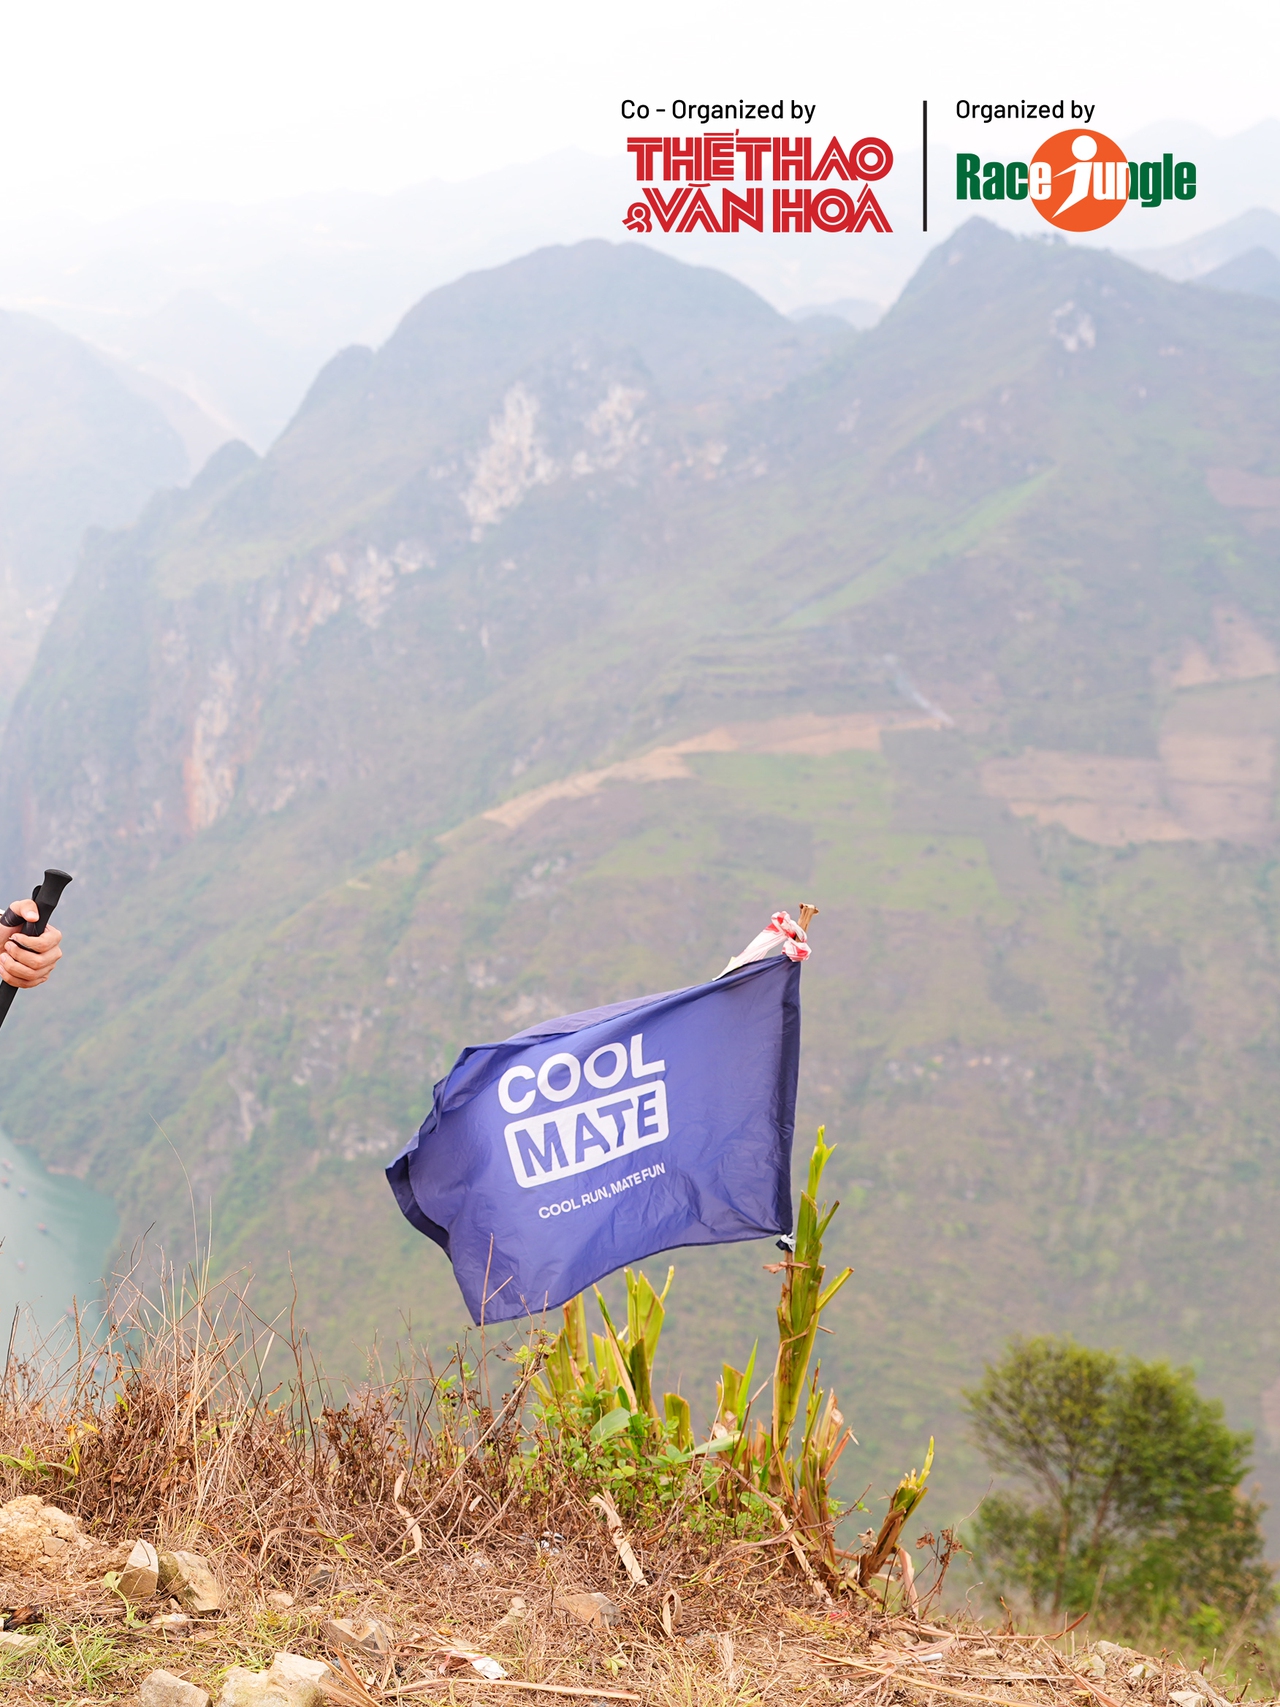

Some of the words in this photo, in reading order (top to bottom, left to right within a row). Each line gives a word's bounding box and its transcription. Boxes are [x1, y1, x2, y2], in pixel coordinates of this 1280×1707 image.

[498, 1033, 666, 1114] COOL
[514, 1090, 659, 1178] MATE
[538, 1198, 581, 1219] COOL
[581, 1187, 612, 1206] RUN,
[610, 1172, 642, 1195] MATE
[641, 1162, 666, 1181] FUN
